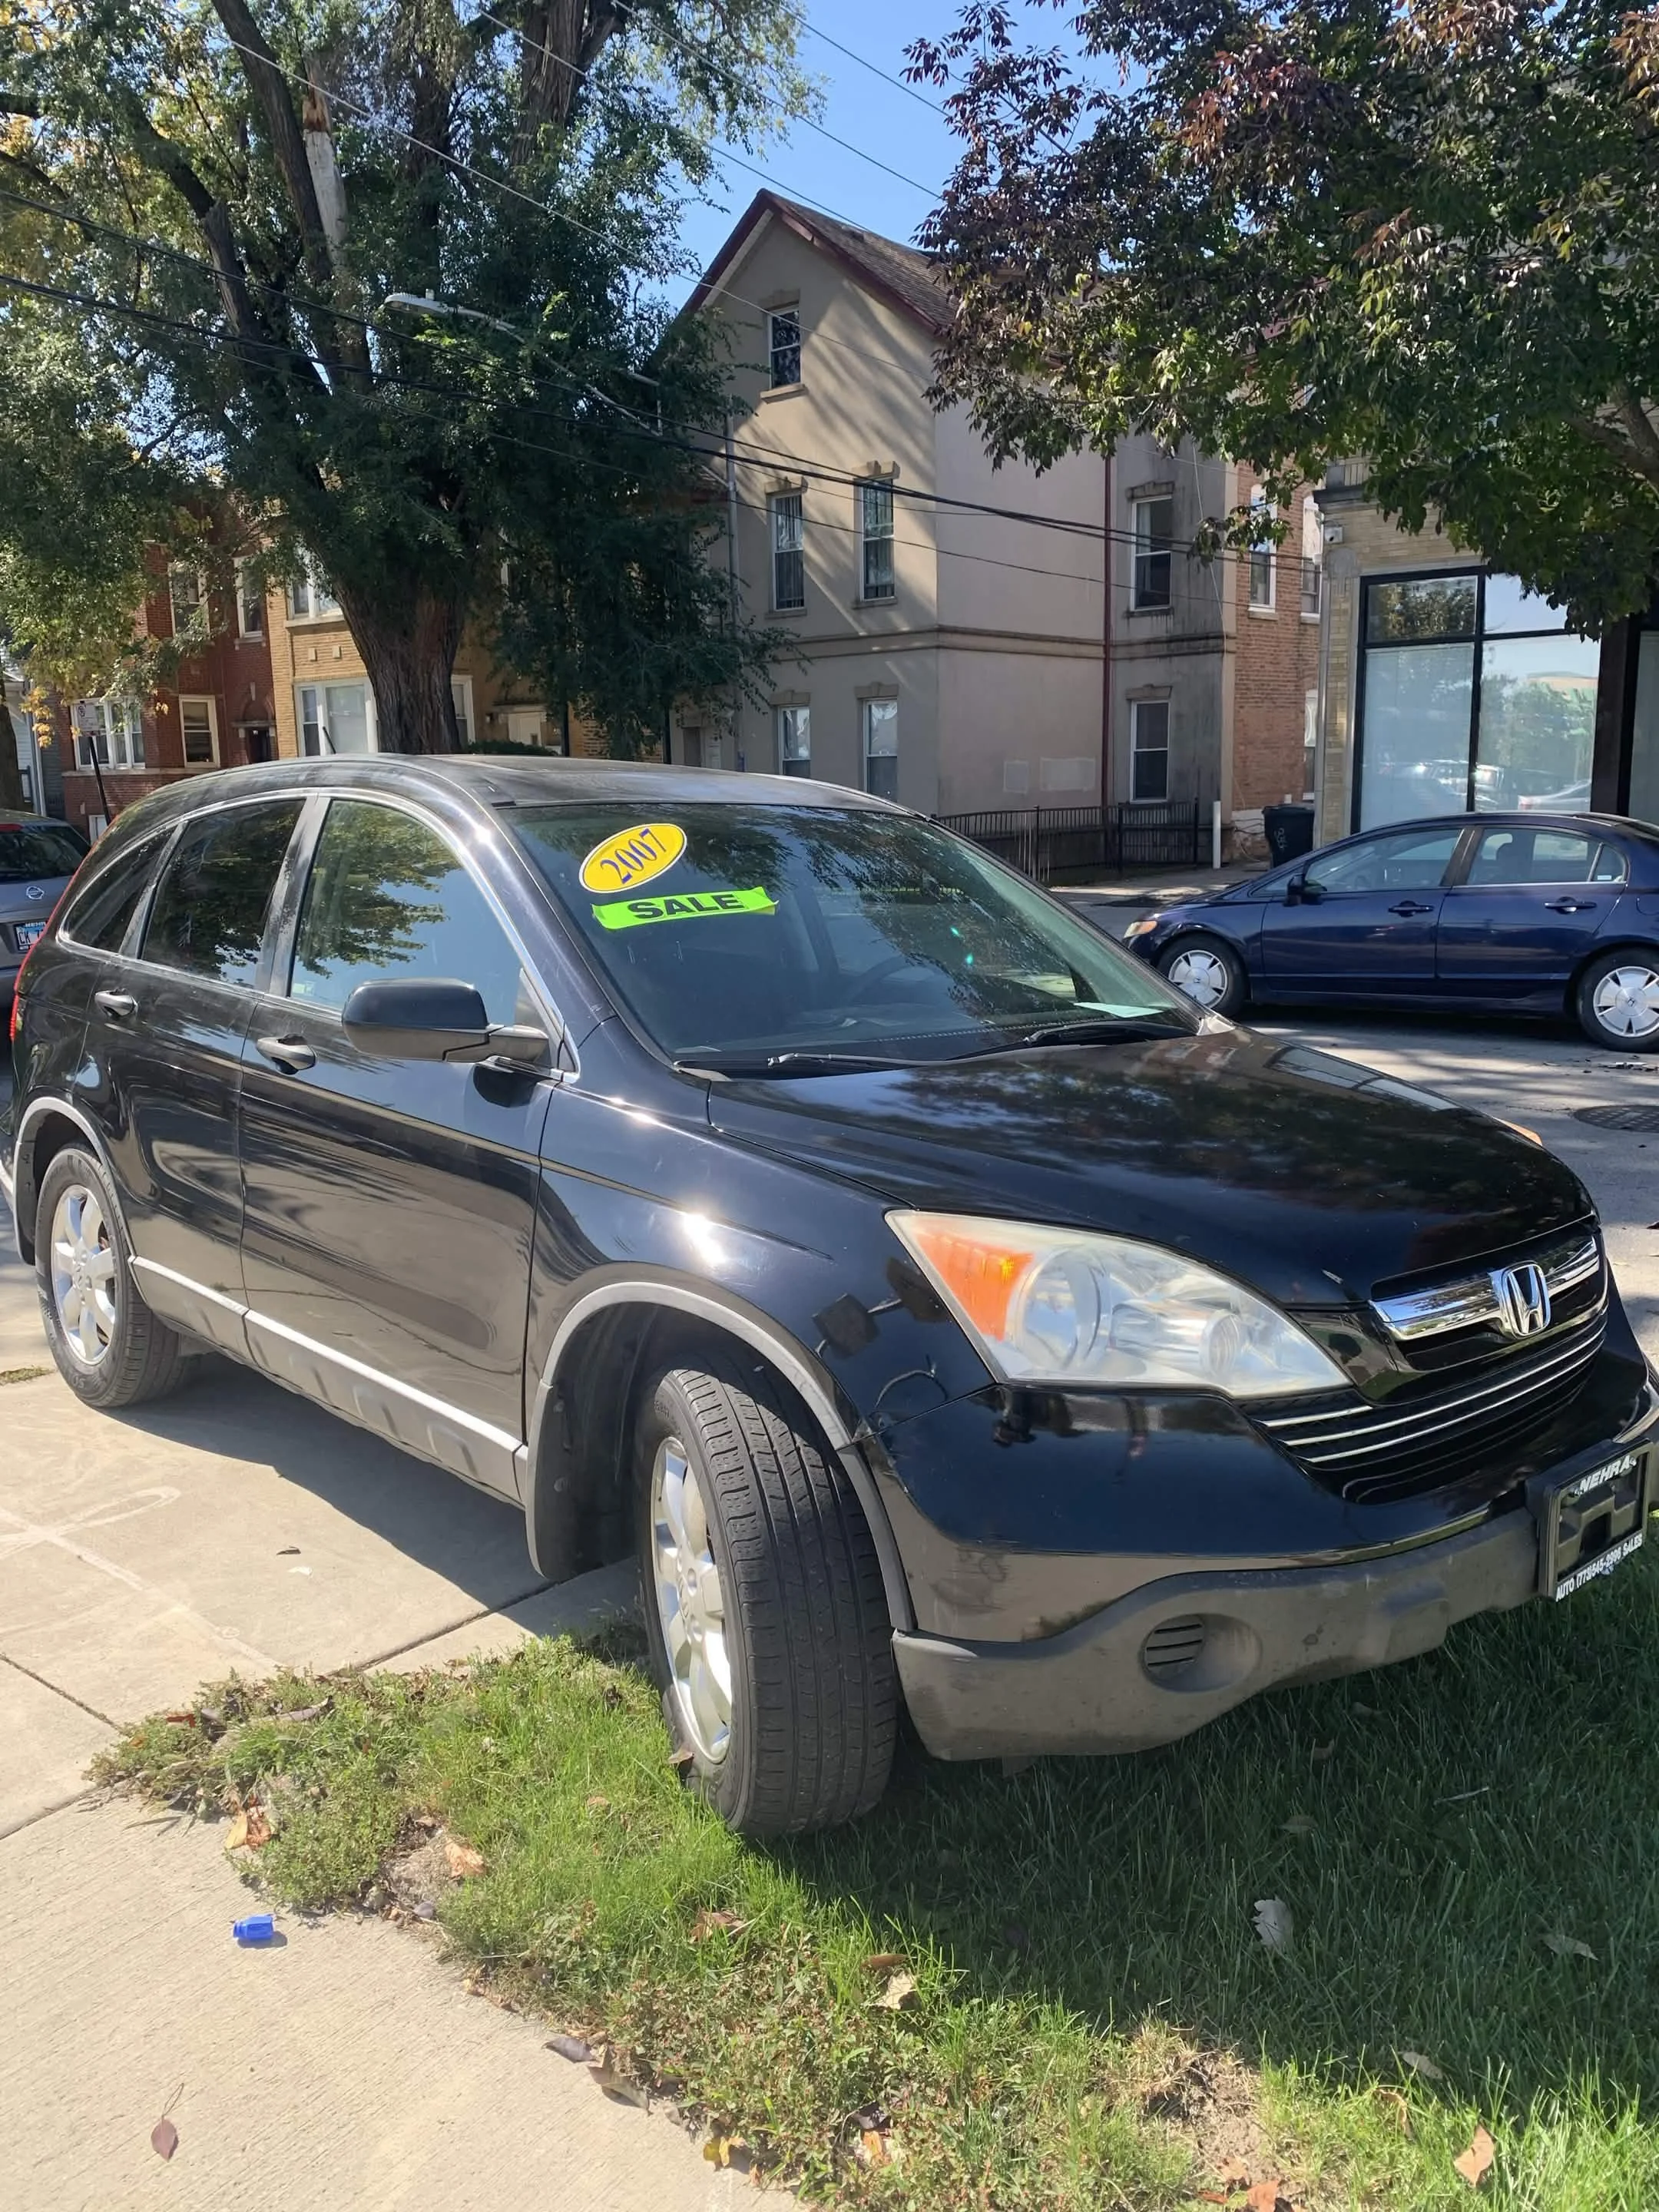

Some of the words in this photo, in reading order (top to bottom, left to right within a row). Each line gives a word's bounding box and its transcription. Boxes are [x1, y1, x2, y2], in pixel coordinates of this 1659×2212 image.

[600, 828, 667, 884] 2007
[628, 894, 744, 919] SALE
[1579, 1455, 1630, 1495] NEHRA
[1555, 1577, 1575, 1603] AUTO
[1623, 1532, 1642, 1557] SALES
